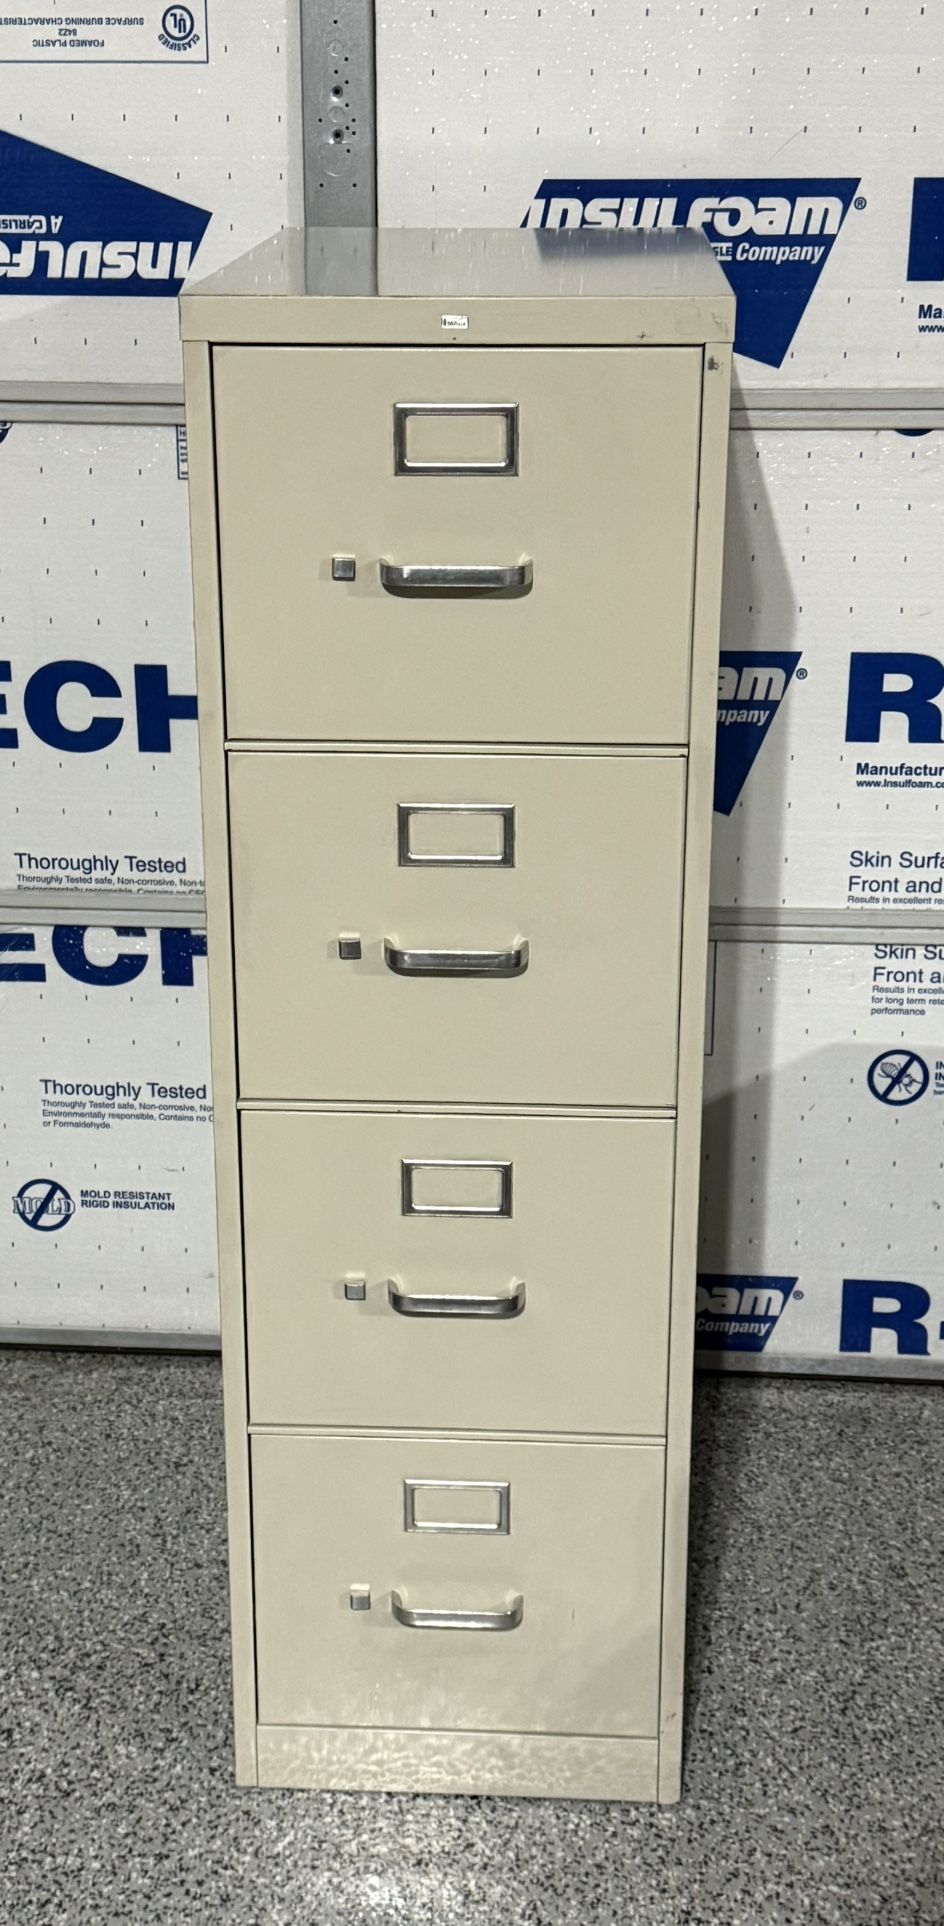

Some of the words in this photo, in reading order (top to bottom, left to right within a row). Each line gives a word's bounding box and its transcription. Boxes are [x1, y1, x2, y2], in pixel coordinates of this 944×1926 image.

[65, 17, 104, 26] BURNING
[104, 17, 145, 26] SURFACE
[32, 39, 67, 48] PLASTIC
[70, 39, 105, 48] FOAMED
[158, 33, 201, 51] CLASSIFIED
[51, 215, 64, 234] A
[0, 240, 193, 280] INSULF
[736, 242, 825, 265] Company
[918, 303, 944, 319] Ma
[14, 852, 119, 875] Thoroughly
[124, 855, 187, 873] Tested
[849, 850, 892, 868] Skin
[17, 874, 63, 886] Thoroughly
[66, 875, 93, 884] Tested
[95, 876, 115, 885] safe,
[117, 877, 177, 887] Non-corrosive,
[848, 876, 899, 892] Front
[905, 877, 943, 894] and
[847, 896, 880, 904] Results
[882, 896, 890, 904] in
[892, 896, 932, 905] excellent
[874, 944, 916, 960] Skin
[872, 966, 924, 983] Front
[872, 985, 904, 994] Results
[906, 985, 915, 994] in
[871, 995, 883, 1004] for
[885, 996, 904, 1006] long
[906, 996, 926, 1005] term
[870, 1006, 926, 1017] performance
[40, 1079, 142, 1100] Thoroughly
[147, 1082, 207, 1099] Tested
[42, 1099, 87, 1111] Thoroughly
[89, 1100, 116, 1109] Tested
[117, 1101, 137, 1111] safe,
[139, 1103, 198, 1112] Non-corrosive,
[42, 1109, 106, 1121] Environmentally
[108, 1111, 157, 1122] responsible,
[158, 1113, 194, 1122] Contains
[80, 1189, 112, 1200] MOLD
[113, 1190, 173, 1201] RESISTANT
[80, 1199, 110, 1209] RIGID
[112, 1201, 176, 1211] INSULATION
[695, 1317, 772, 1337] Company
